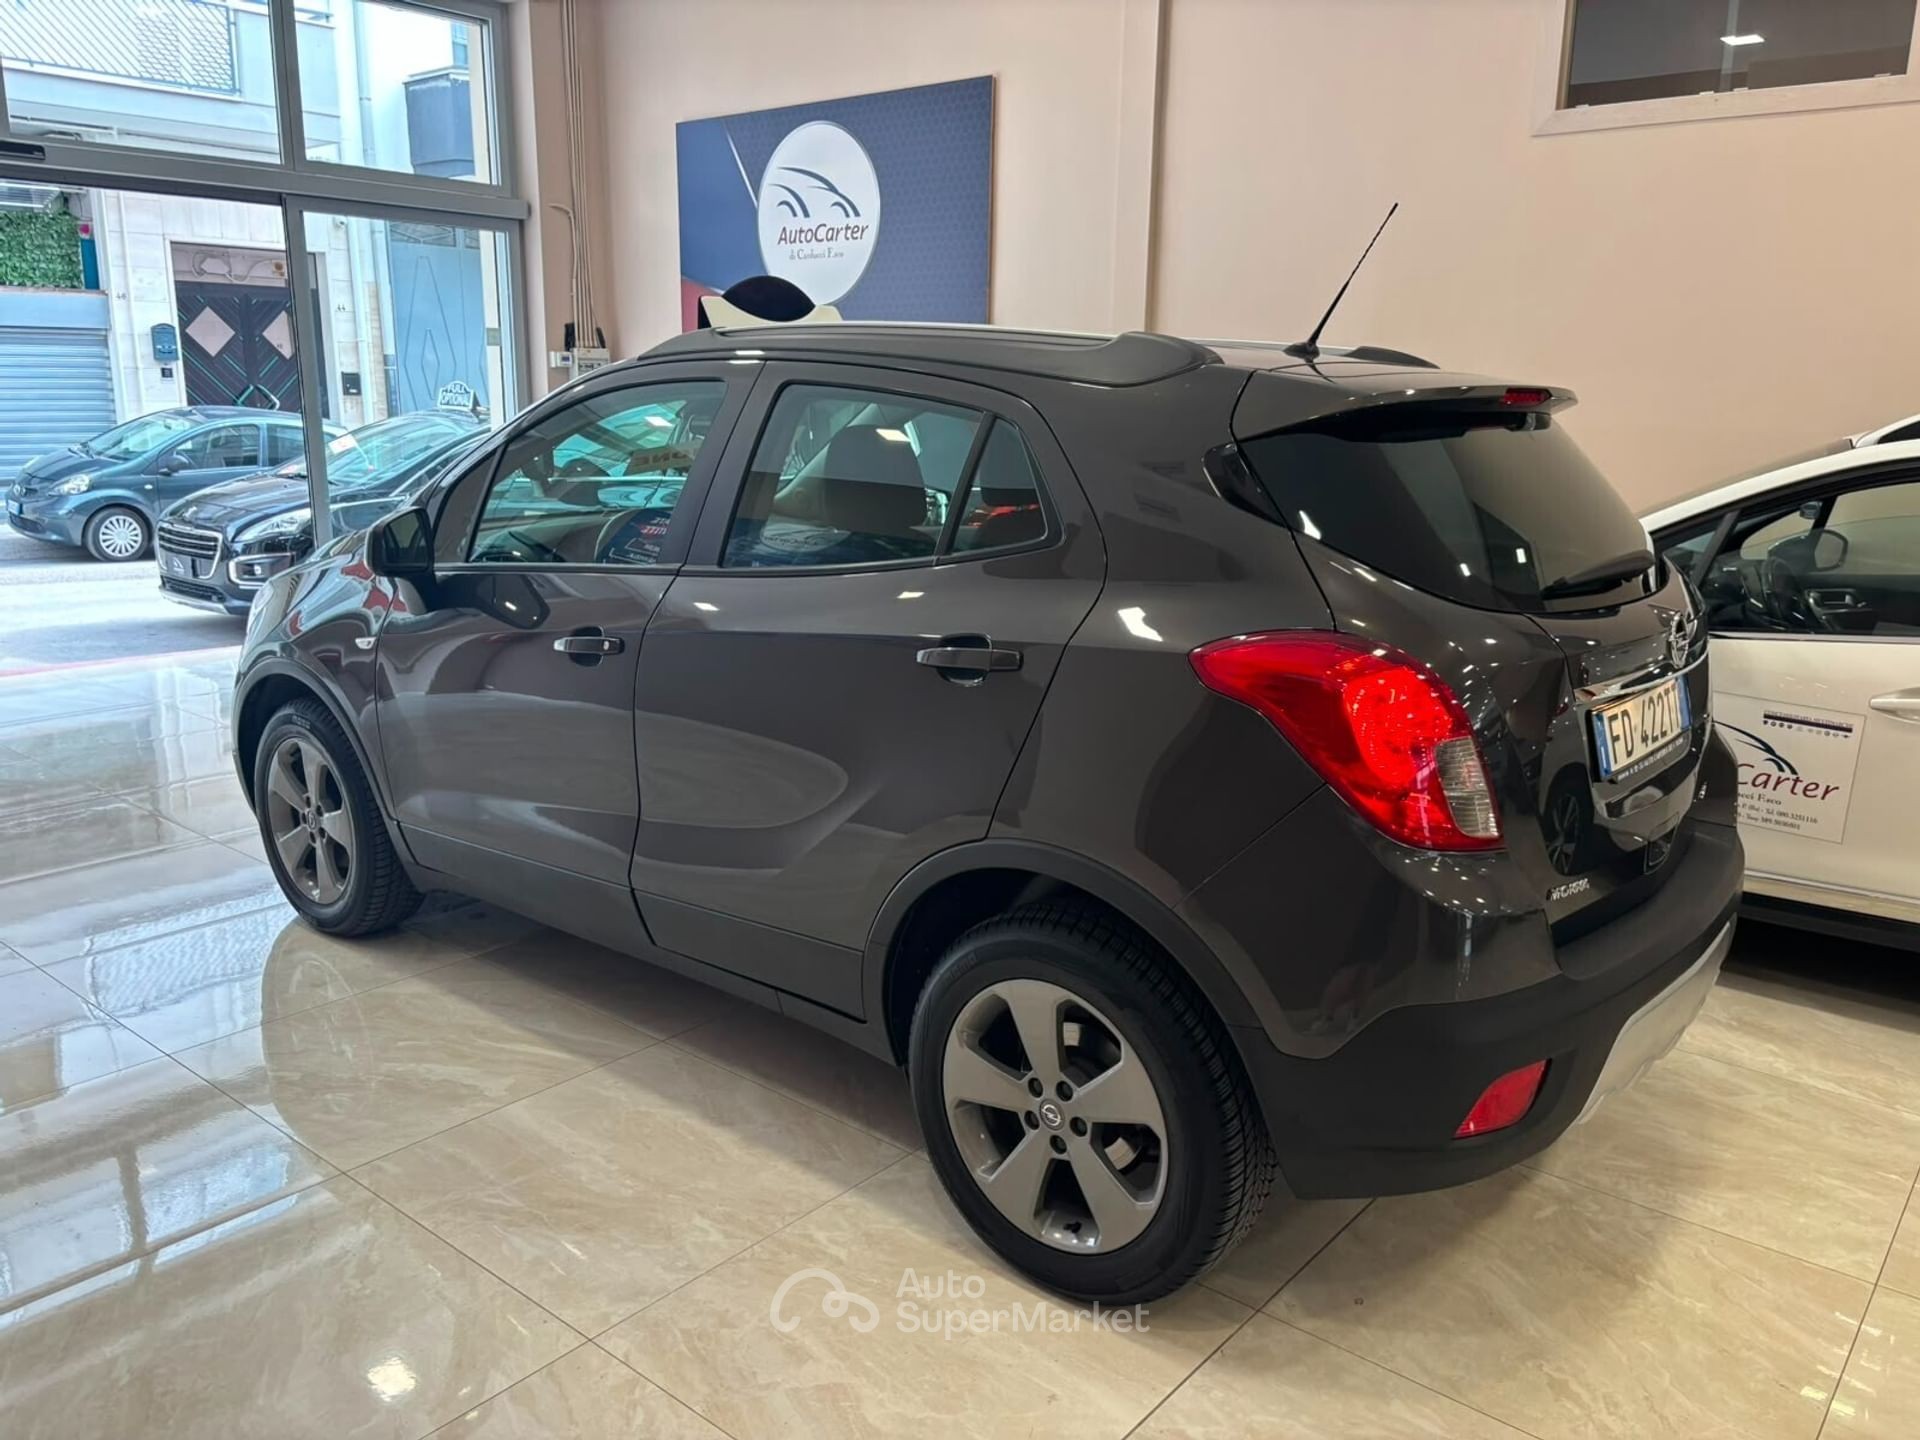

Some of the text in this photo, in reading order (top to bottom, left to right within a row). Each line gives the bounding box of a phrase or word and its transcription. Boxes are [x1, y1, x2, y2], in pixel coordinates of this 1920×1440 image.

[777, 223, 869, 245] AutoCarter
[1607, 708, 1635, 765] FD
[1641, 682, 1680, 748] 422TT
[1738, 763, 1840, 801] Carter
